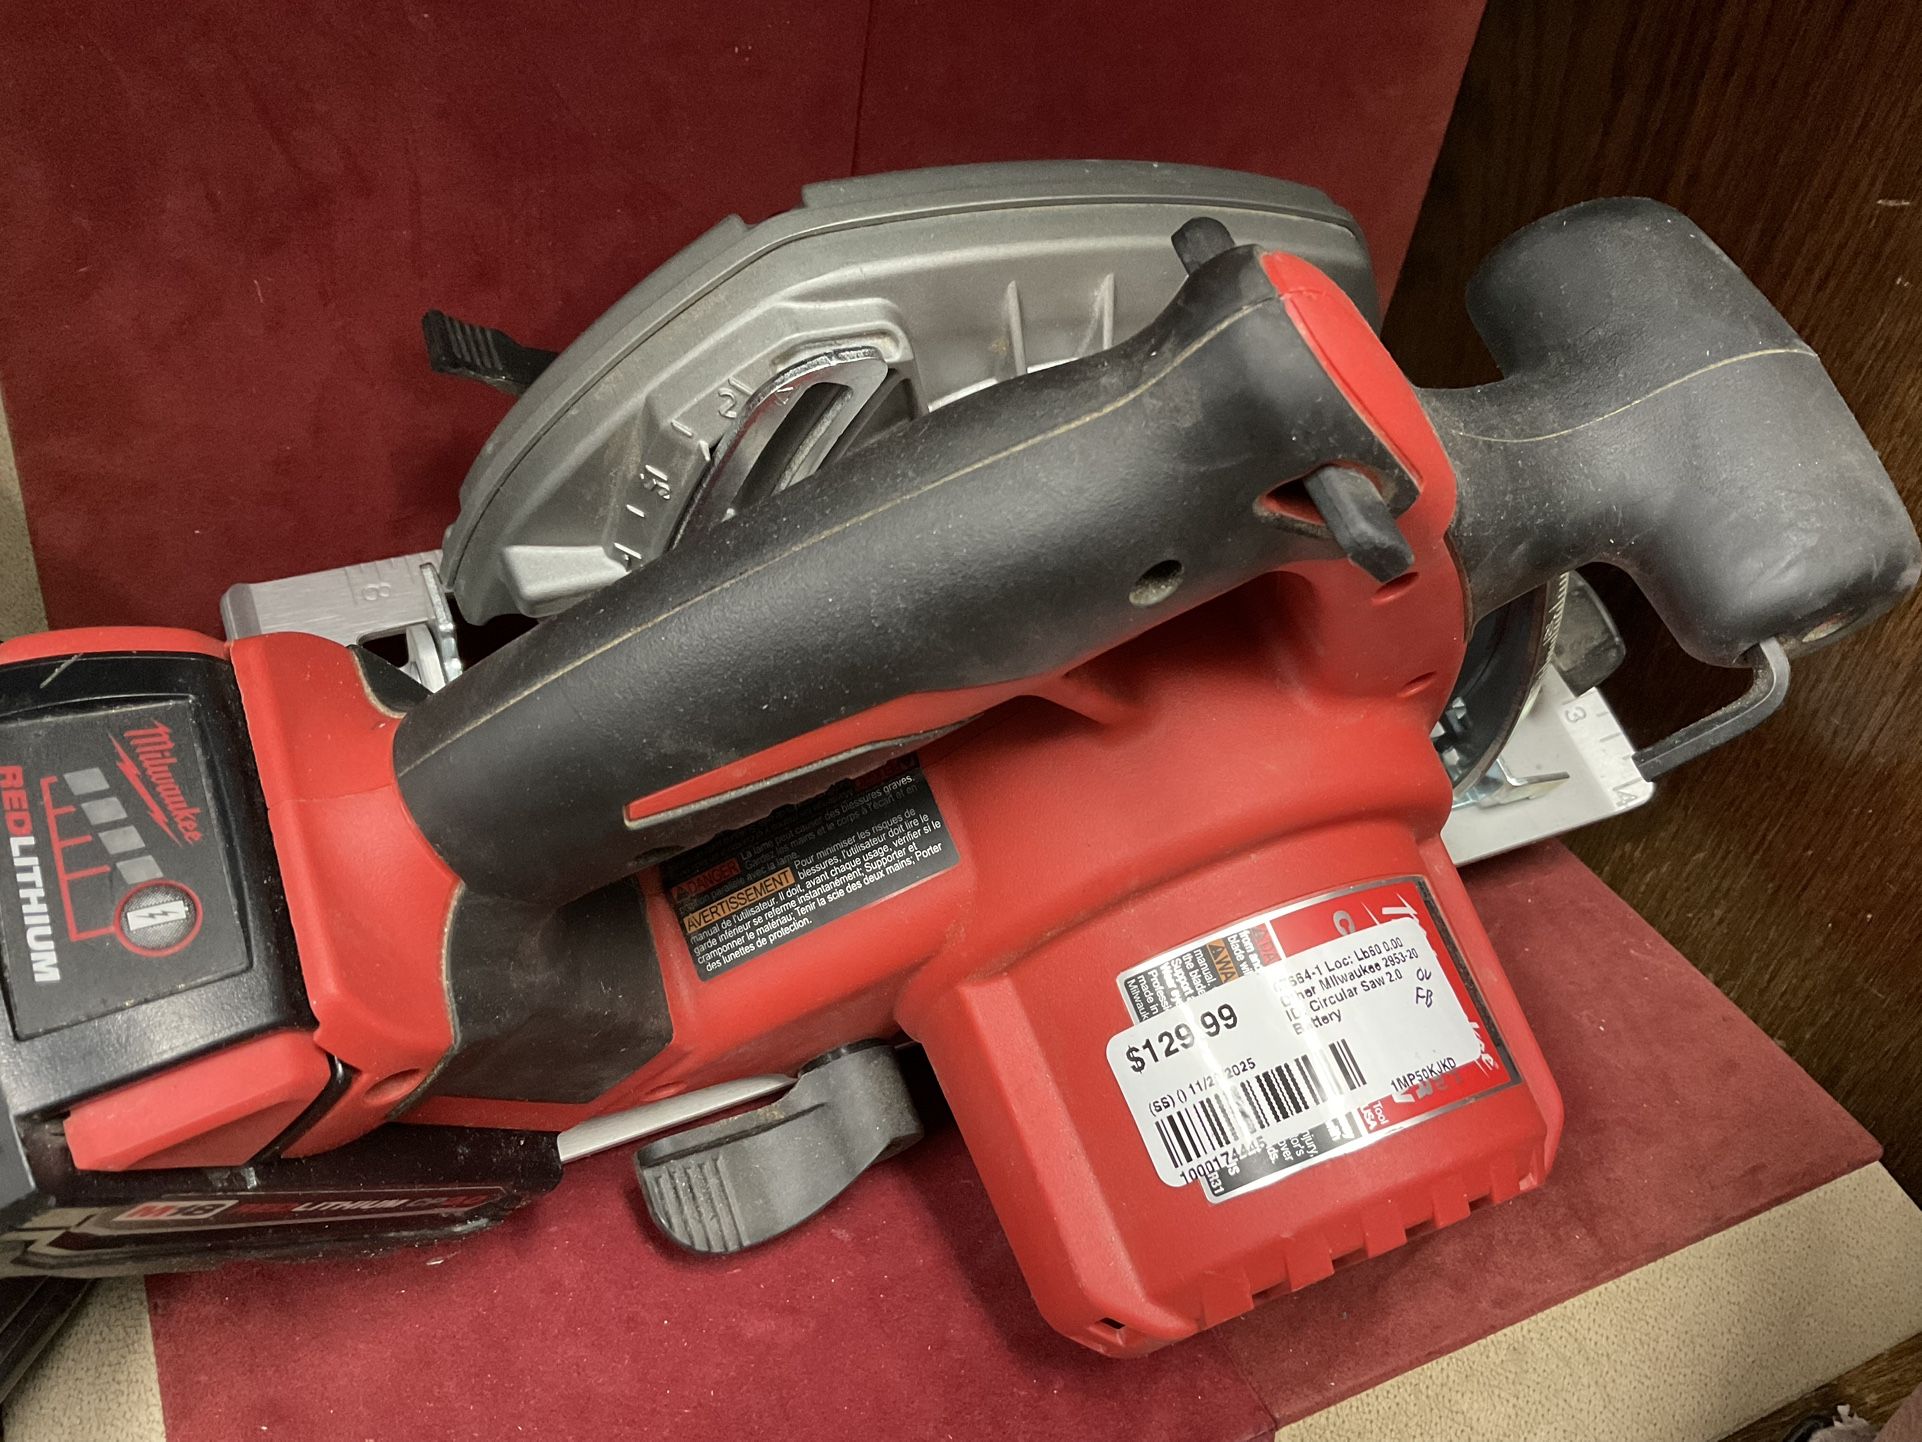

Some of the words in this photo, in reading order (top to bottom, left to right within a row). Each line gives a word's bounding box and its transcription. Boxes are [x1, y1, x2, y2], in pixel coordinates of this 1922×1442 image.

[123, 718, 203, 846] Milwaukee
[883, 774, 915, 795] graves.
[795, 855, 814, 869] Pour
[816, 836, 857, 859] minimiser
[858, 829, 870, 840] les
[872, 814, 903, 835] risques
[904, 807, 915, 819] de
[799, 855, 841, 880] blessures,
[842, 832, 887, 859] l'utilisateur
[887, 824, 904, 838] doit
[905, 817, 919, 830] lire
[920, 813, 928, 823] le
[688, 861, 738, 894] DANGER
[690, 924, 719, 944] manual
[721, 919, 732, 929] de
[733, 897, 778, 923] l'utilisateur.
[785, 884, 804, 898] doit,
[805, 872, 828, 888] avant
[830, 857, 862, 879] chaque
[863, 844, 892, 864] usage,
[892, 828, 922, 848] vérifier
[923, 824, 930, 834] si
[932, 819, 941, 829] le
[687, 869, 789, 932] AVERTISSEMENT
[693, 938, 718, 956] garde
[718, 921, 752, 942] inférieur
[753, 917, 763, 925] se
[764, 899, 796, 920] referme
[797, 867, 864, 905] instantanément;
[864, 847, 907, 874] Supporter
[908, 843, 917, 852] et
[697, 936, 747, 966] cramponner
[747, 931, 754, 940] le
[755, 911, 794, 936] matériau;
[795, 901, 816, 917] Tenir
[817, 896, 826, 906] la
[827, 888, 844, 902] scie
[845, 880, 862, 893] des
[863, 869, 884, 885] deux
[885, 855, 914, 876] mains;
[915, 842, 943, 861] Porter
[706, 959, 721, 972] des
[722, 943, 755, 964] lunettes
[756, 937, 767, 948] de
[768, 915, 812, 944] protection.
[1182, 952, 1196, 970] the
[1227, 935, 1246, 962] blade
[1239, 929, 1256, 953] from
[1324, 955, 1354, 974] Loc:
[1382, 936, 1404, 953] 0.00
[1171, 957, 1195, 998] Support
[1193, 949, 1218, 987] manual.
[1137, 974, 1154, 1004] made
[1150, 1003, 1159, 1015] in
[1279, 985, 1317, 1008] Oher
[1309, 985, 1359, 1013] Circular
[1360, 976, 1386, 993] Saw
[1385, 968, 1404, 983] 2.0
[1125, 1003, 1238, 1074] $12999
[1292, 1008, 1343, 1035] Bttery
[1370, 1101, 1389, 1124] Tool
[127, 1203, 226, 1218] M18
